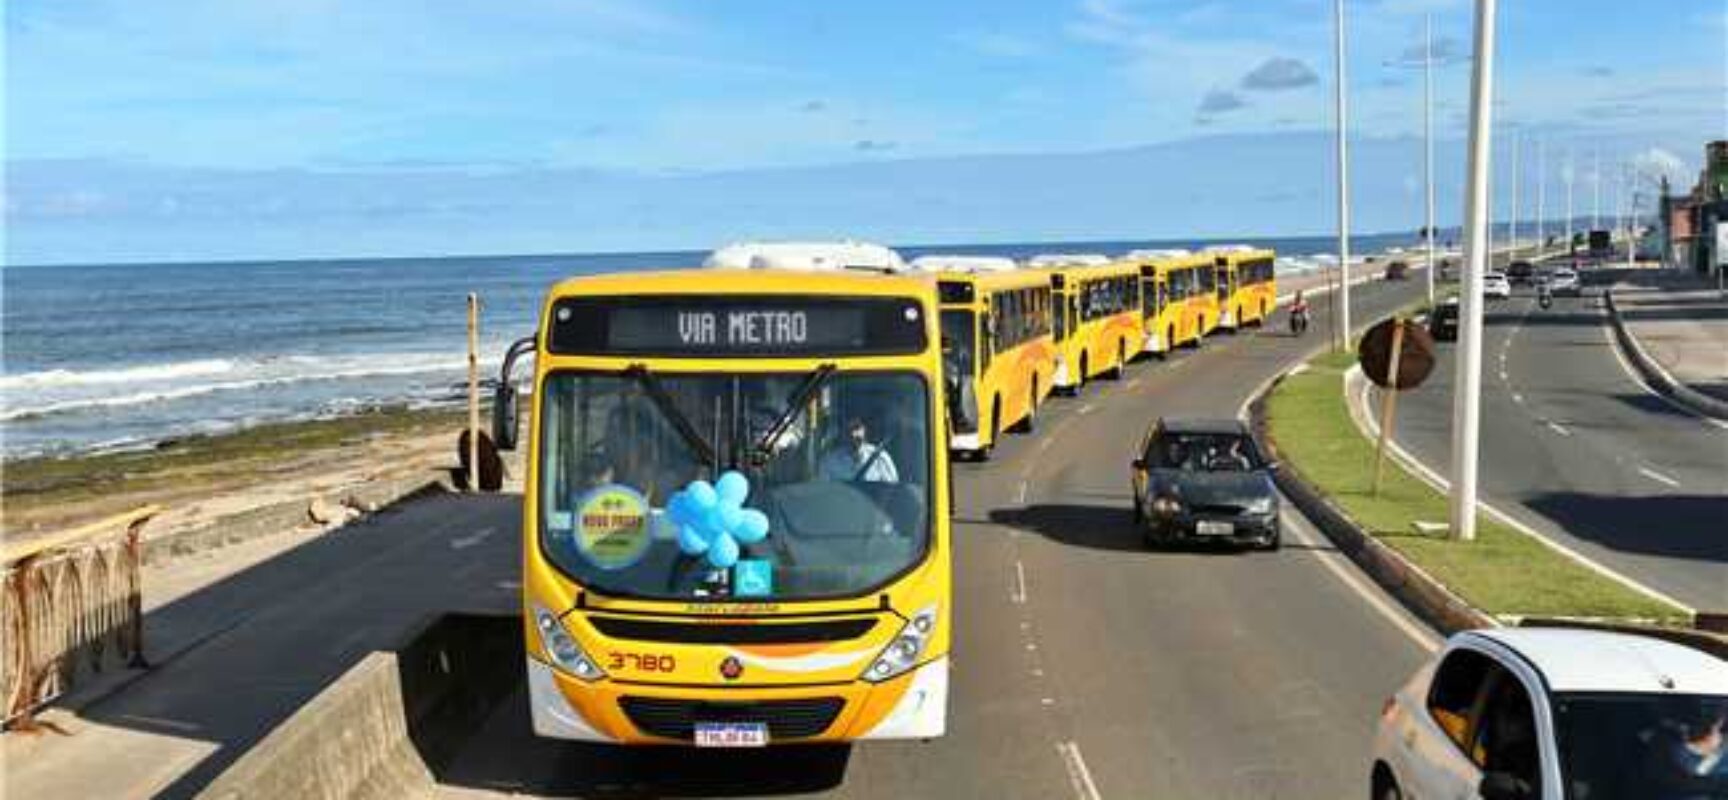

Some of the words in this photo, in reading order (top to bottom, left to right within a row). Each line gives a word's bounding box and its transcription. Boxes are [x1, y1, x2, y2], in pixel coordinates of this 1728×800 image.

[679, 311, 716, 343] VIA
[728, 311, 807, 343] METRO
[608, 652, 676, 673] 3780
